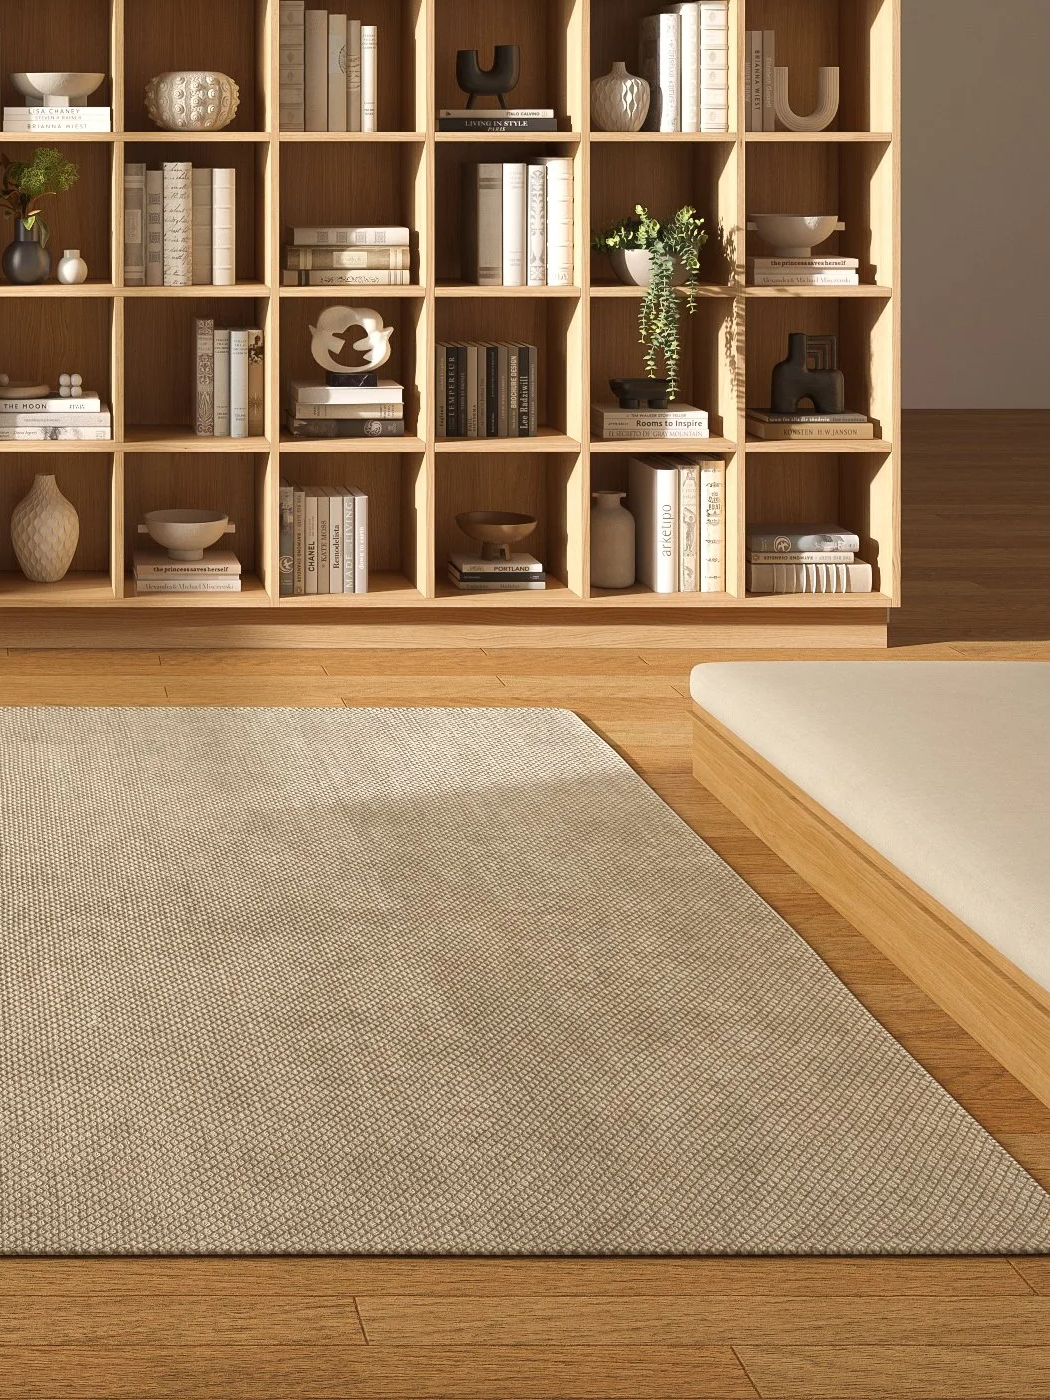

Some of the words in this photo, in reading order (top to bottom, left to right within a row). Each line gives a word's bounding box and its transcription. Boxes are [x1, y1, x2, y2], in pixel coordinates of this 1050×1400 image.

[519, 376, 528, 413] Radziwill
[519, 415, 528, 429] Lee
[675, 420, 703, 429] Inspire
[345, 502, 353, 543] LIVING
[658, 504, 674, 557] arketipo
[332, 524, 340, 569] Remodelista
[345, 554, 353, 588] MADE
